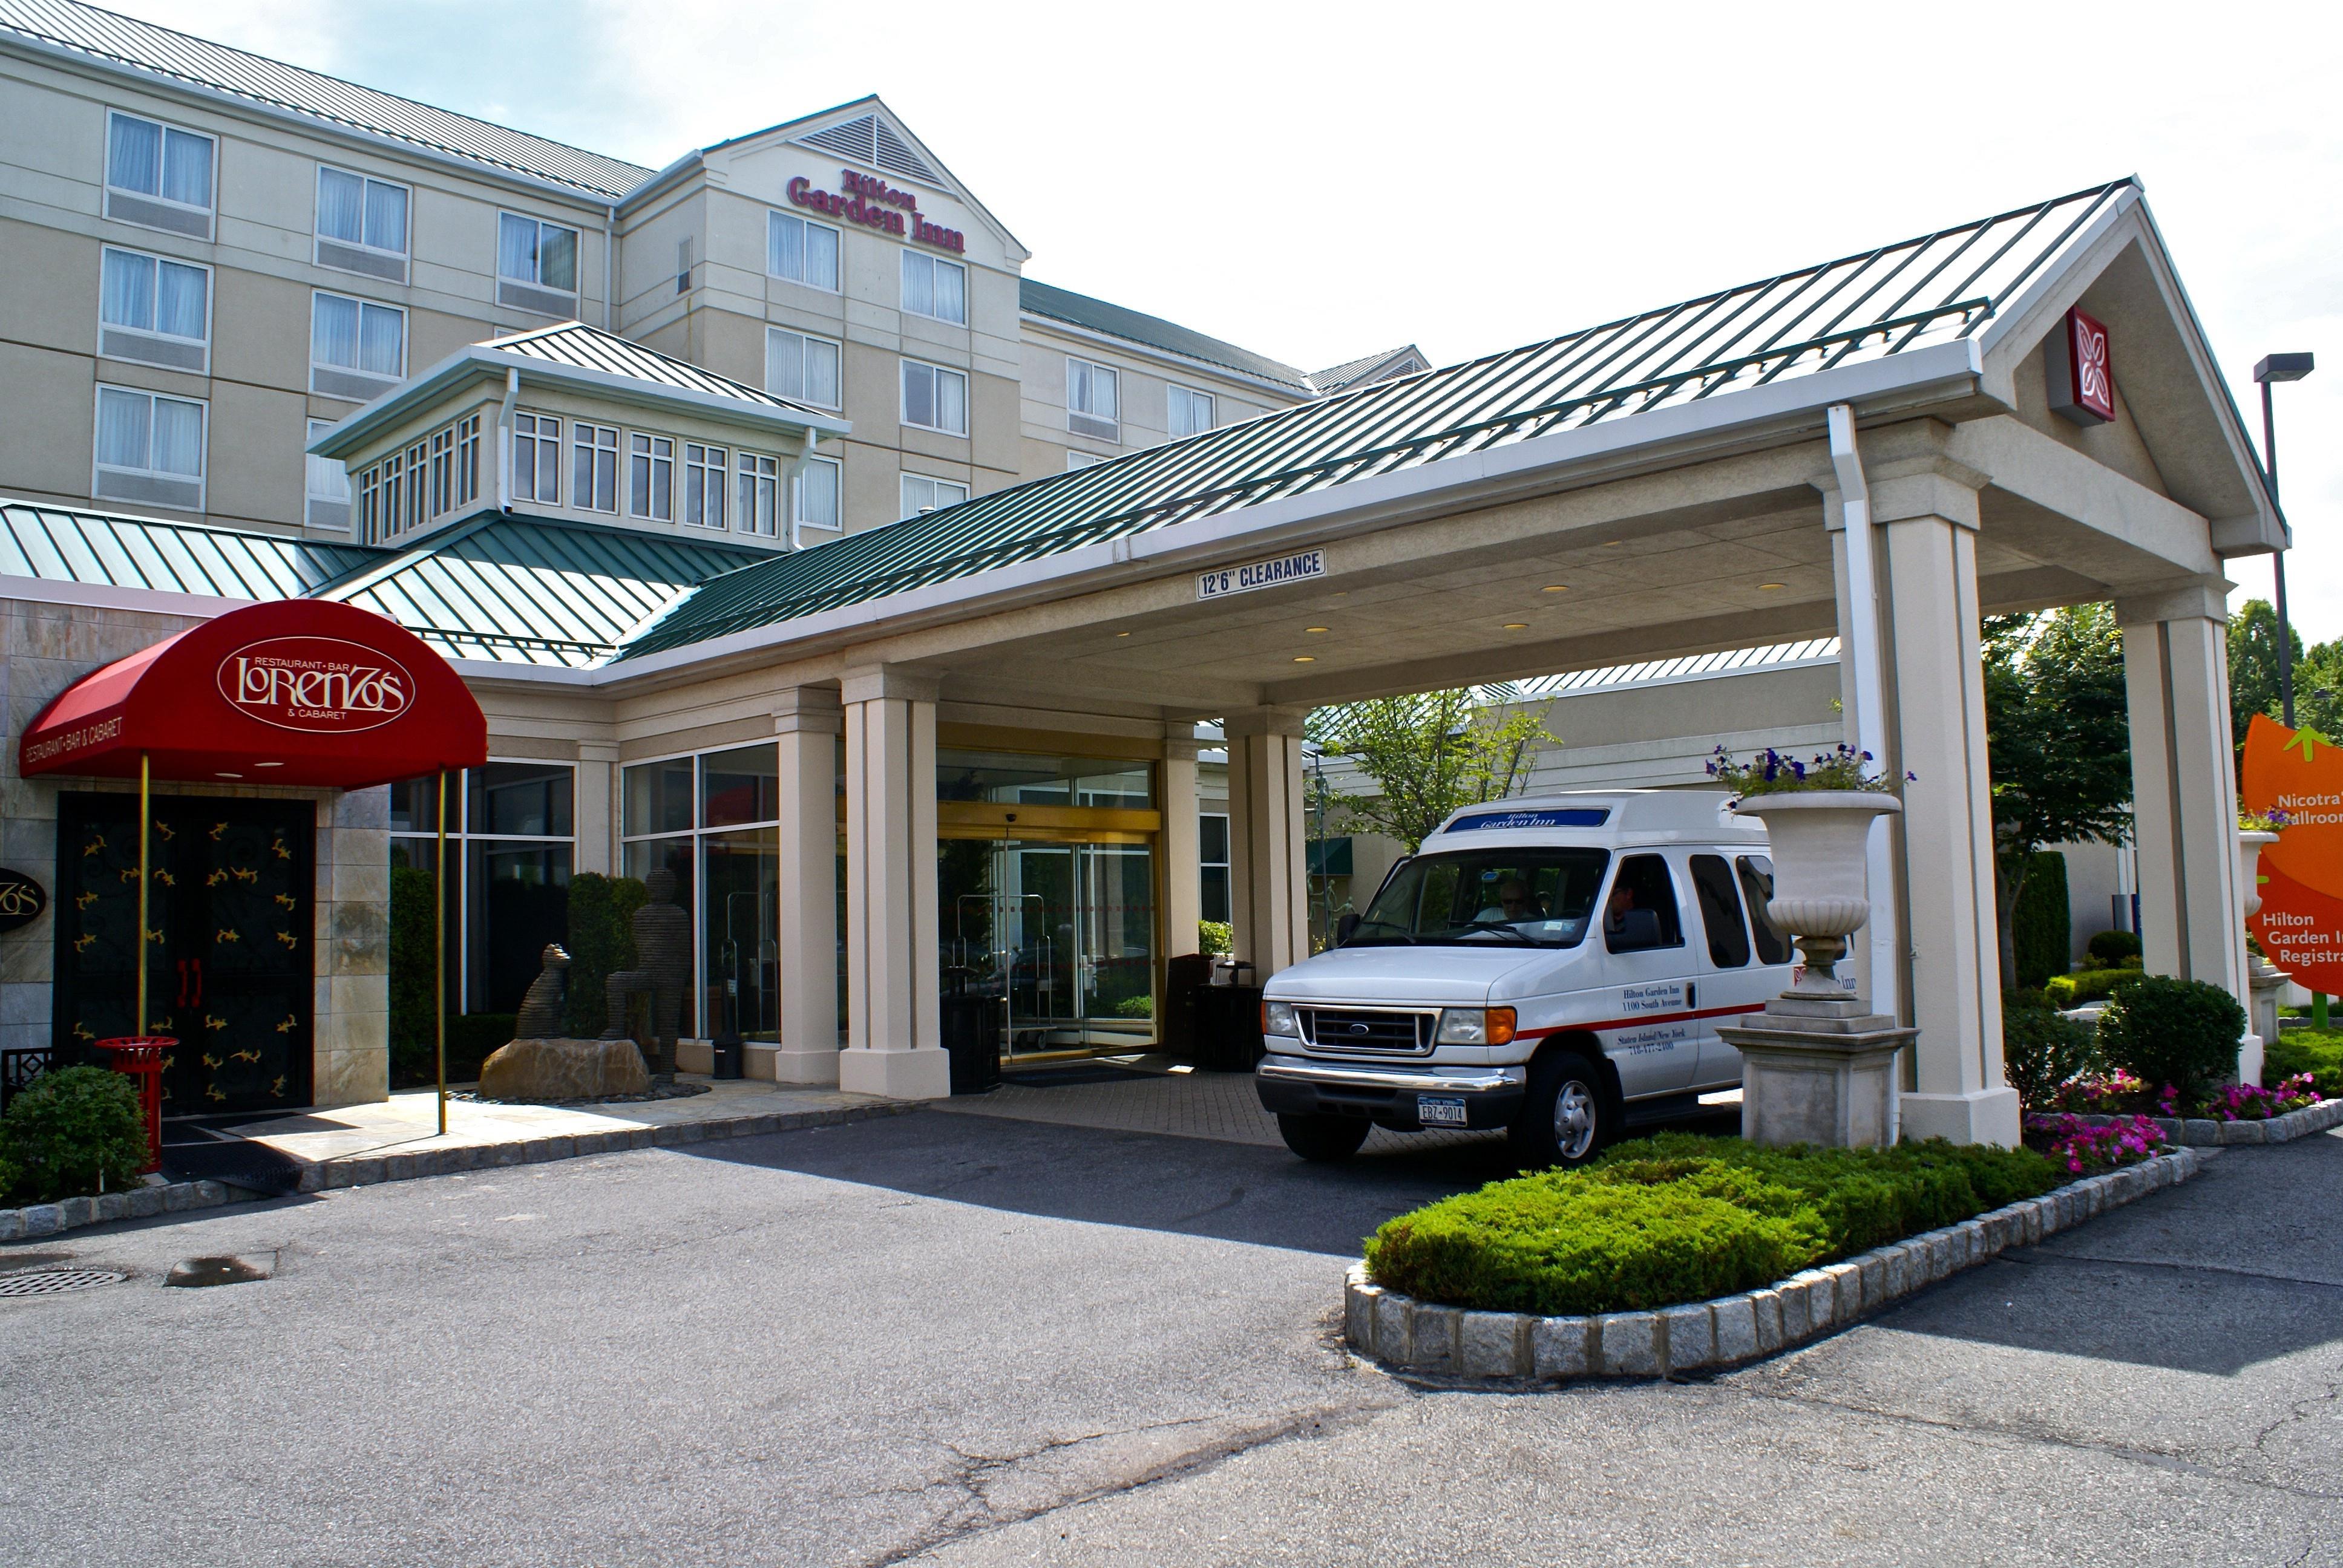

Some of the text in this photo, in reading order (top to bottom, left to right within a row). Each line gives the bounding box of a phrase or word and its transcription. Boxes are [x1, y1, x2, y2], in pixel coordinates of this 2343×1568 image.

[841, 168, 917, 211] Hilton
[787, 176, 966, 253] Garden Inn
[1202, 553, 1320, 595] 12'6" CLEARANCE
[255, 657, 350, 673] RESTAURANT BAR
[287, 709, 347, 720] & CABARET
[82, 729, 88, 746] &
[89, 717, 122, 745] CABARET
[1481, 817, 1529, 828] Garden
[2263, 912, 2314, 926] Hilton
[2268, 930, 2329, 944] Garden
[1624, 985, 1679, 999] Hilton Garden Inn
[1622, 999, 1682, 1011] 1100 South Avenue
[1423, 1105, 1462, 1120] EBZ 9014
